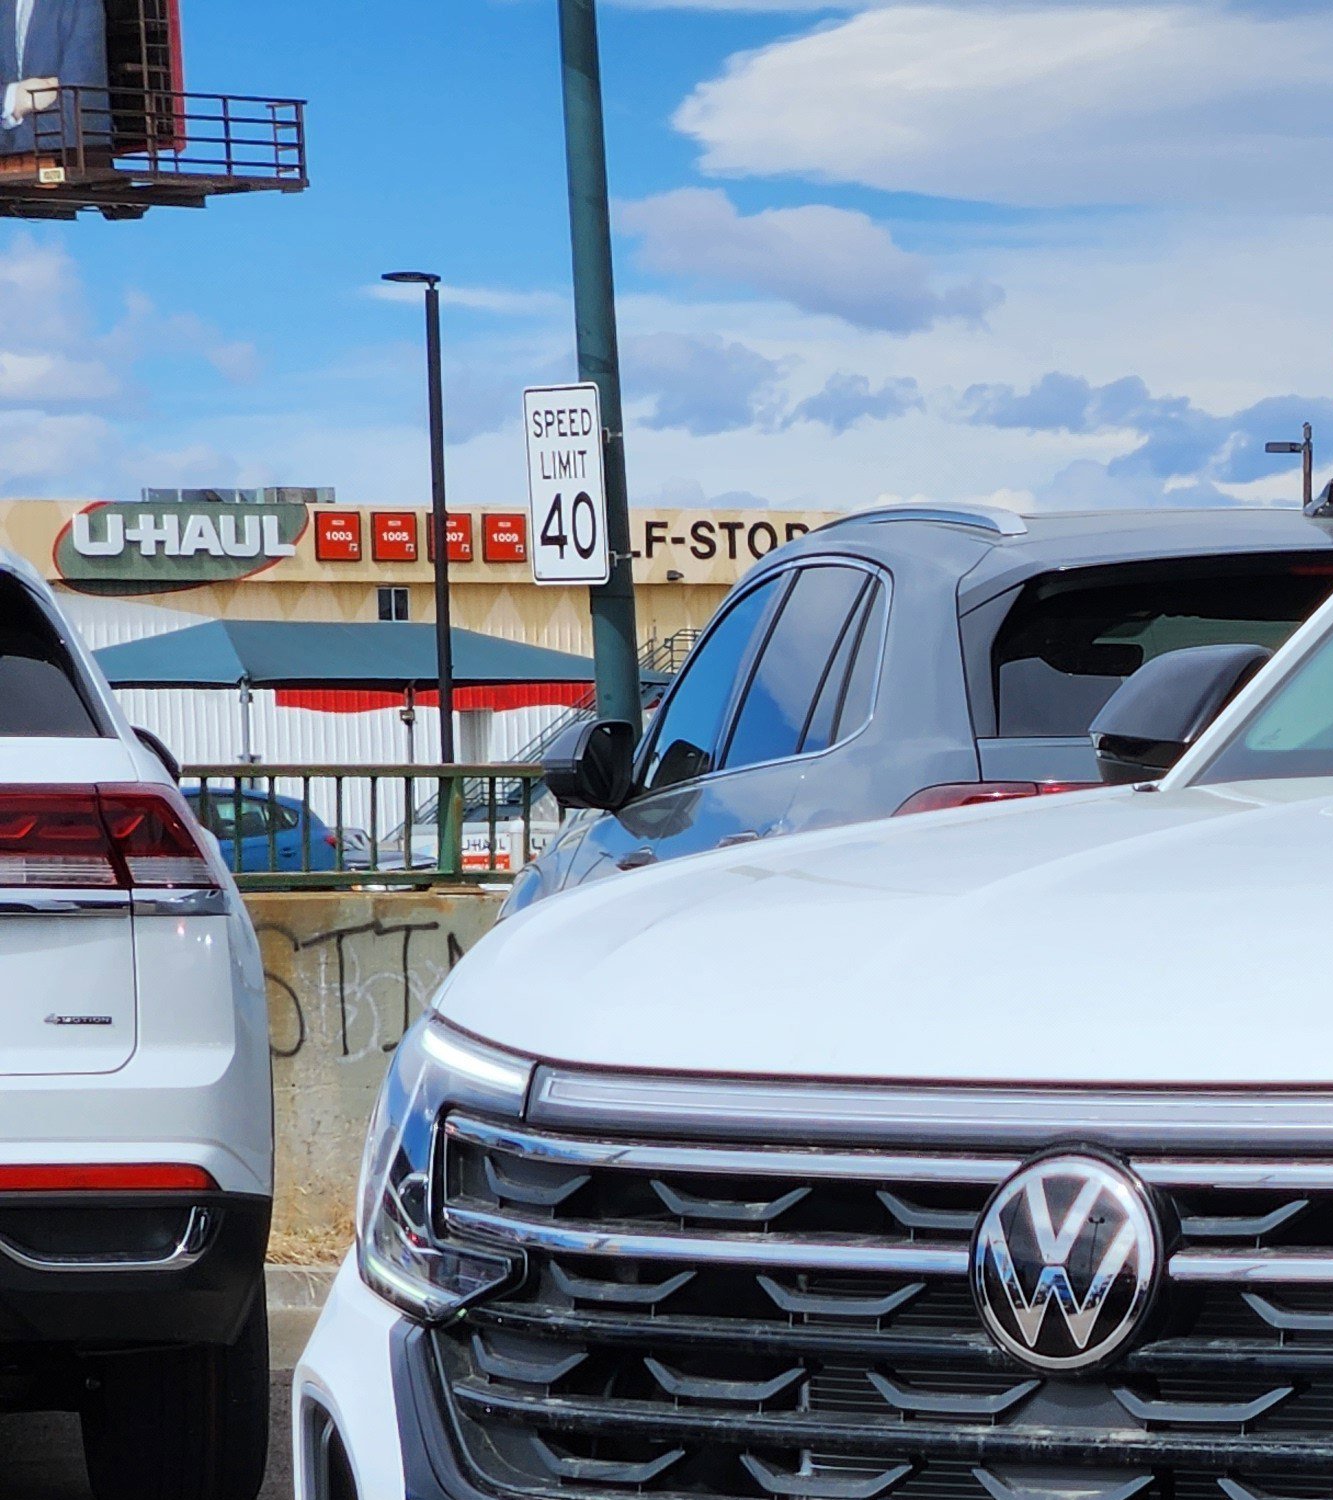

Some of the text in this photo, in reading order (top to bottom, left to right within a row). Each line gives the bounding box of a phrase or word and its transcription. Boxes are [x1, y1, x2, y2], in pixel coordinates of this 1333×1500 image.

[532, 407, 592, 438] SPEED
[540, 450, 587, 480] LIMIT
[325, 531, 353, 541] 1003
[382, 531, 410, 541] 1005
[540, 491, 597, 559] 40
